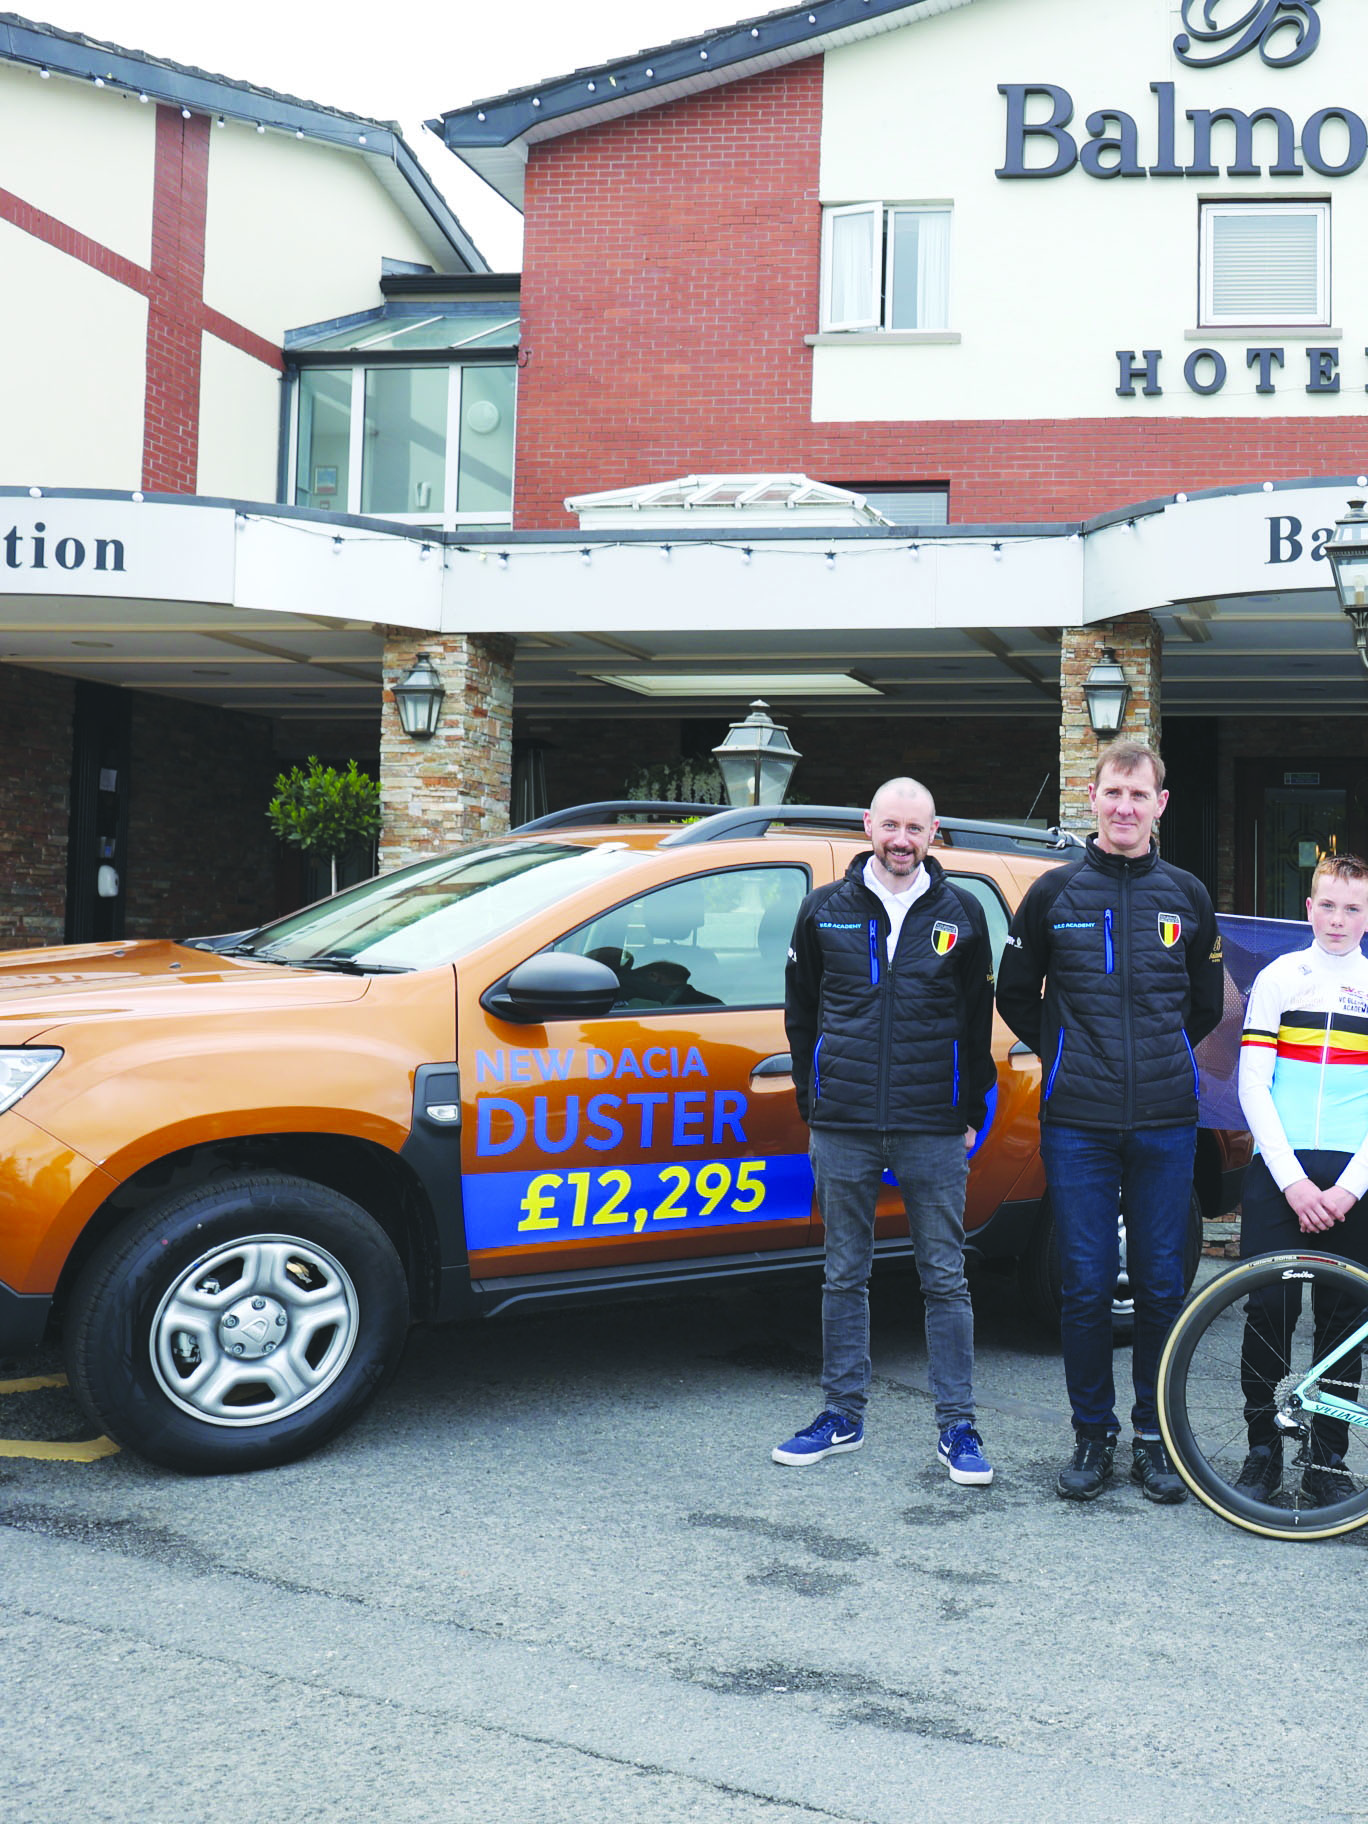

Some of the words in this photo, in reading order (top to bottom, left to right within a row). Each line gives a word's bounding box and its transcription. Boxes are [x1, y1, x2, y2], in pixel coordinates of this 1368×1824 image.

[2, 521, 127, 572] tion
[475, 1049, 575, 1083] NEW
[585, 1046, 709, 1080] DACIA
[476, 1089, 749, 1157] DUSTER
[517, 1160, 767, 1233] £12,295
